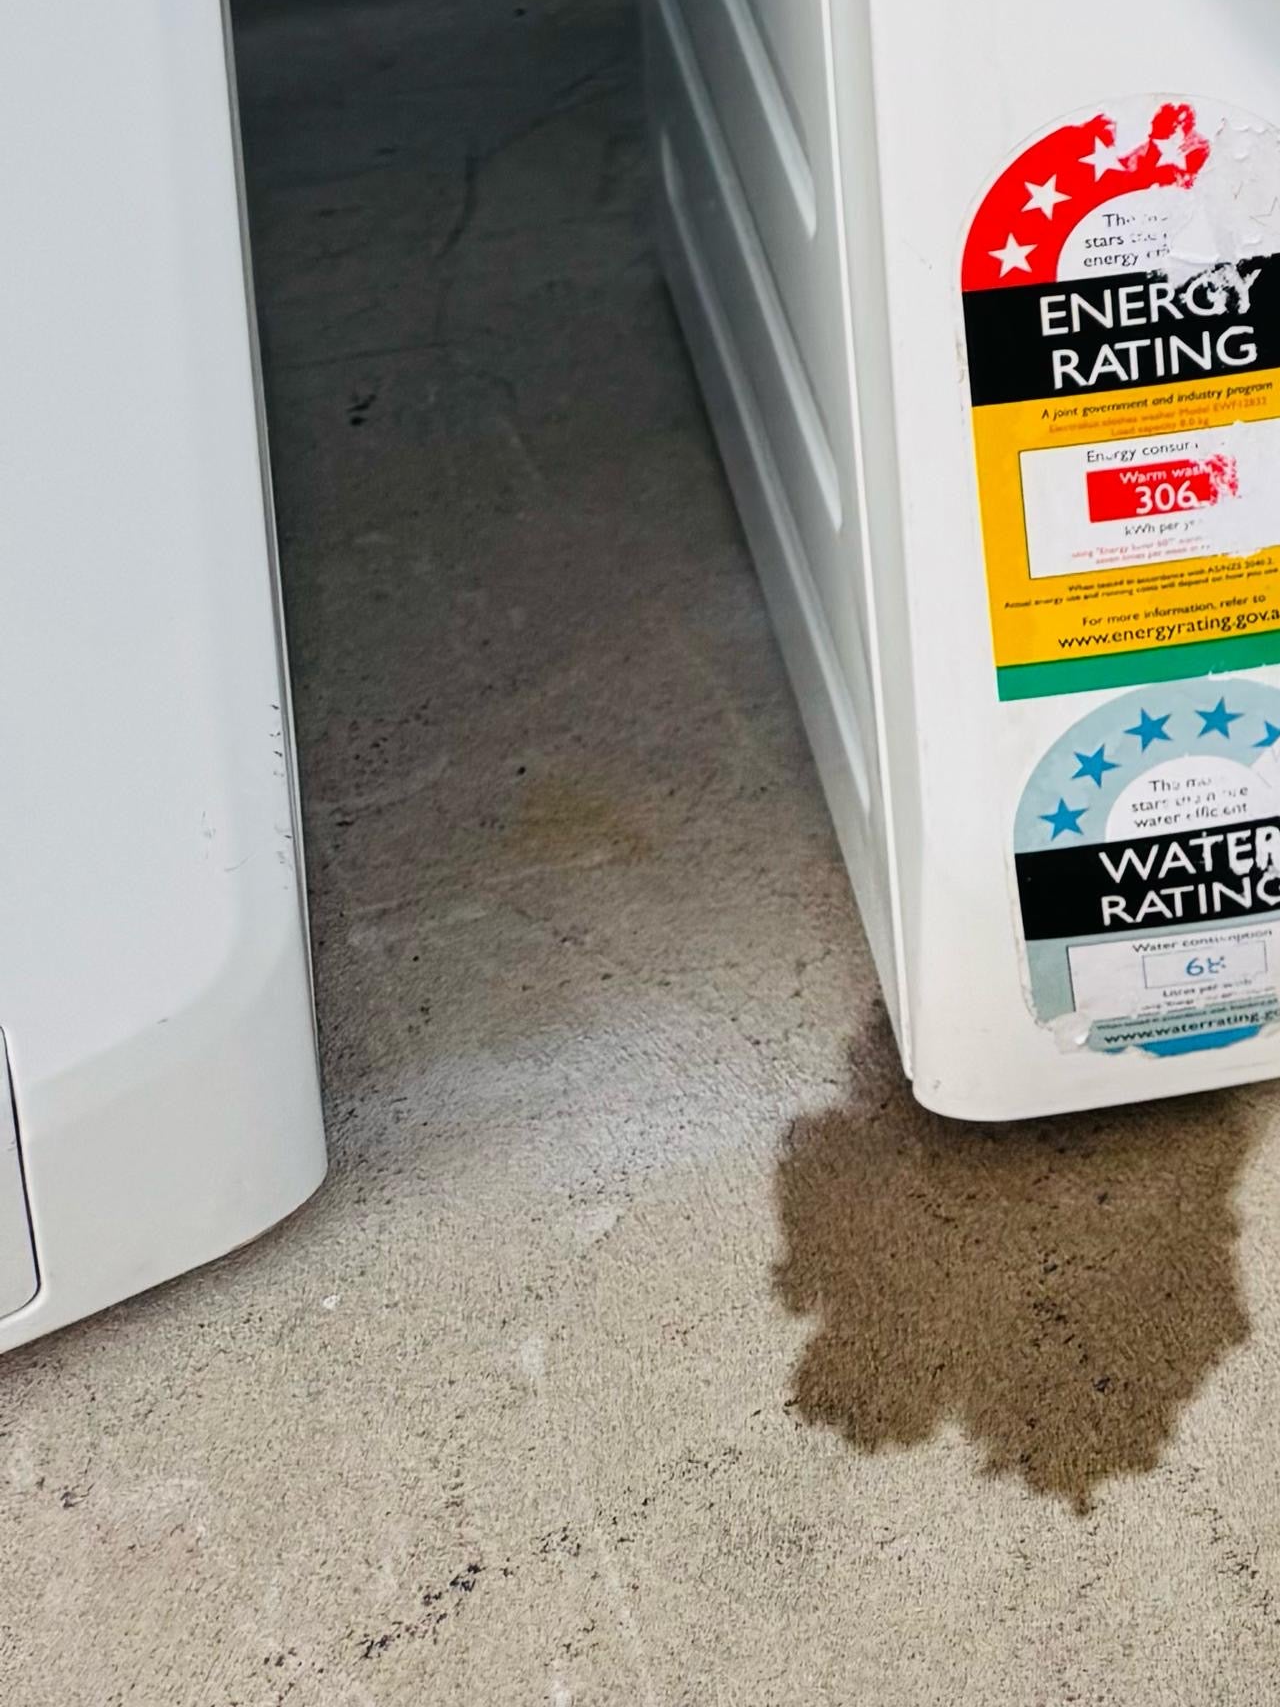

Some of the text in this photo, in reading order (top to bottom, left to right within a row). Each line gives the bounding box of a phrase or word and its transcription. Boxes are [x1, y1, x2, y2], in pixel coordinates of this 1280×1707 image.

[1085, 234, 1125, 249] stars
[1083, 252, 1139, 268] energy
[1039, 268, 1263, 337] ENERGY
[1051, 325, 1258, 391] RATING
[1041, 382, 1273, 421] A joint government and industry program
[1120, 469, 1168, 485] Warm
[1134, 480, 1199, 515] 306
[1124, 523, 1156, 536] kWh
[1159, 522, 1179, 534] per
[1082, 617, 1103, 627] For
[1106, 612, 1140, 624] more
[1219, 597, 1248, 609] refer
[1252, 594, 1267, 604] to
[1132, 940, 1179, 954] Water
